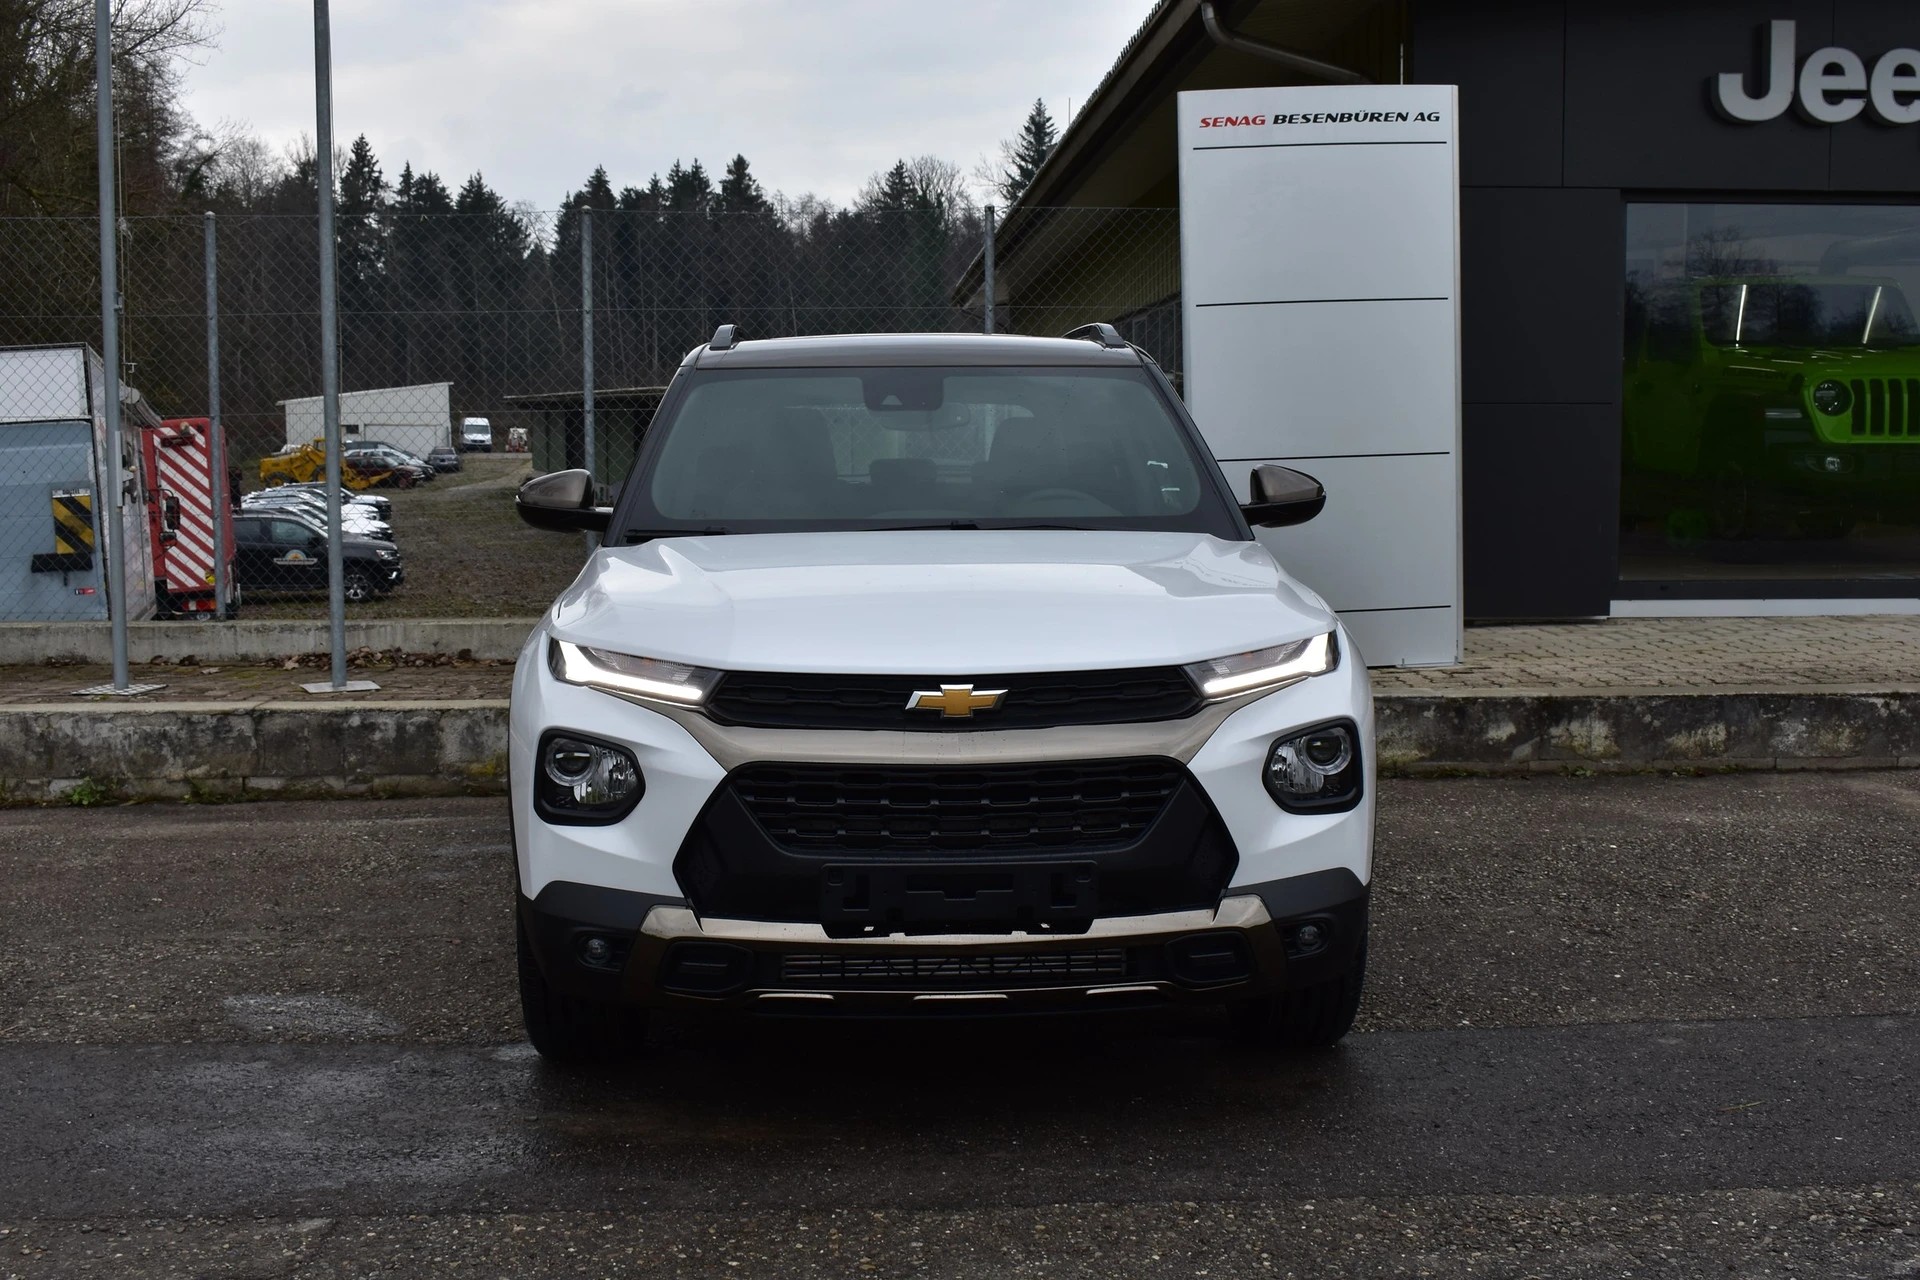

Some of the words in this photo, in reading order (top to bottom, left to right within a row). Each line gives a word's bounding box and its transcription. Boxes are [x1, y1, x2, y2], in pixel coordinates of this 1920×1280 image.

[1199, 114, 1266, 128] SENAG
[1272, 109, 1409, 125] BESENBÜREN
[1412, 111, 1441, 123] AG
